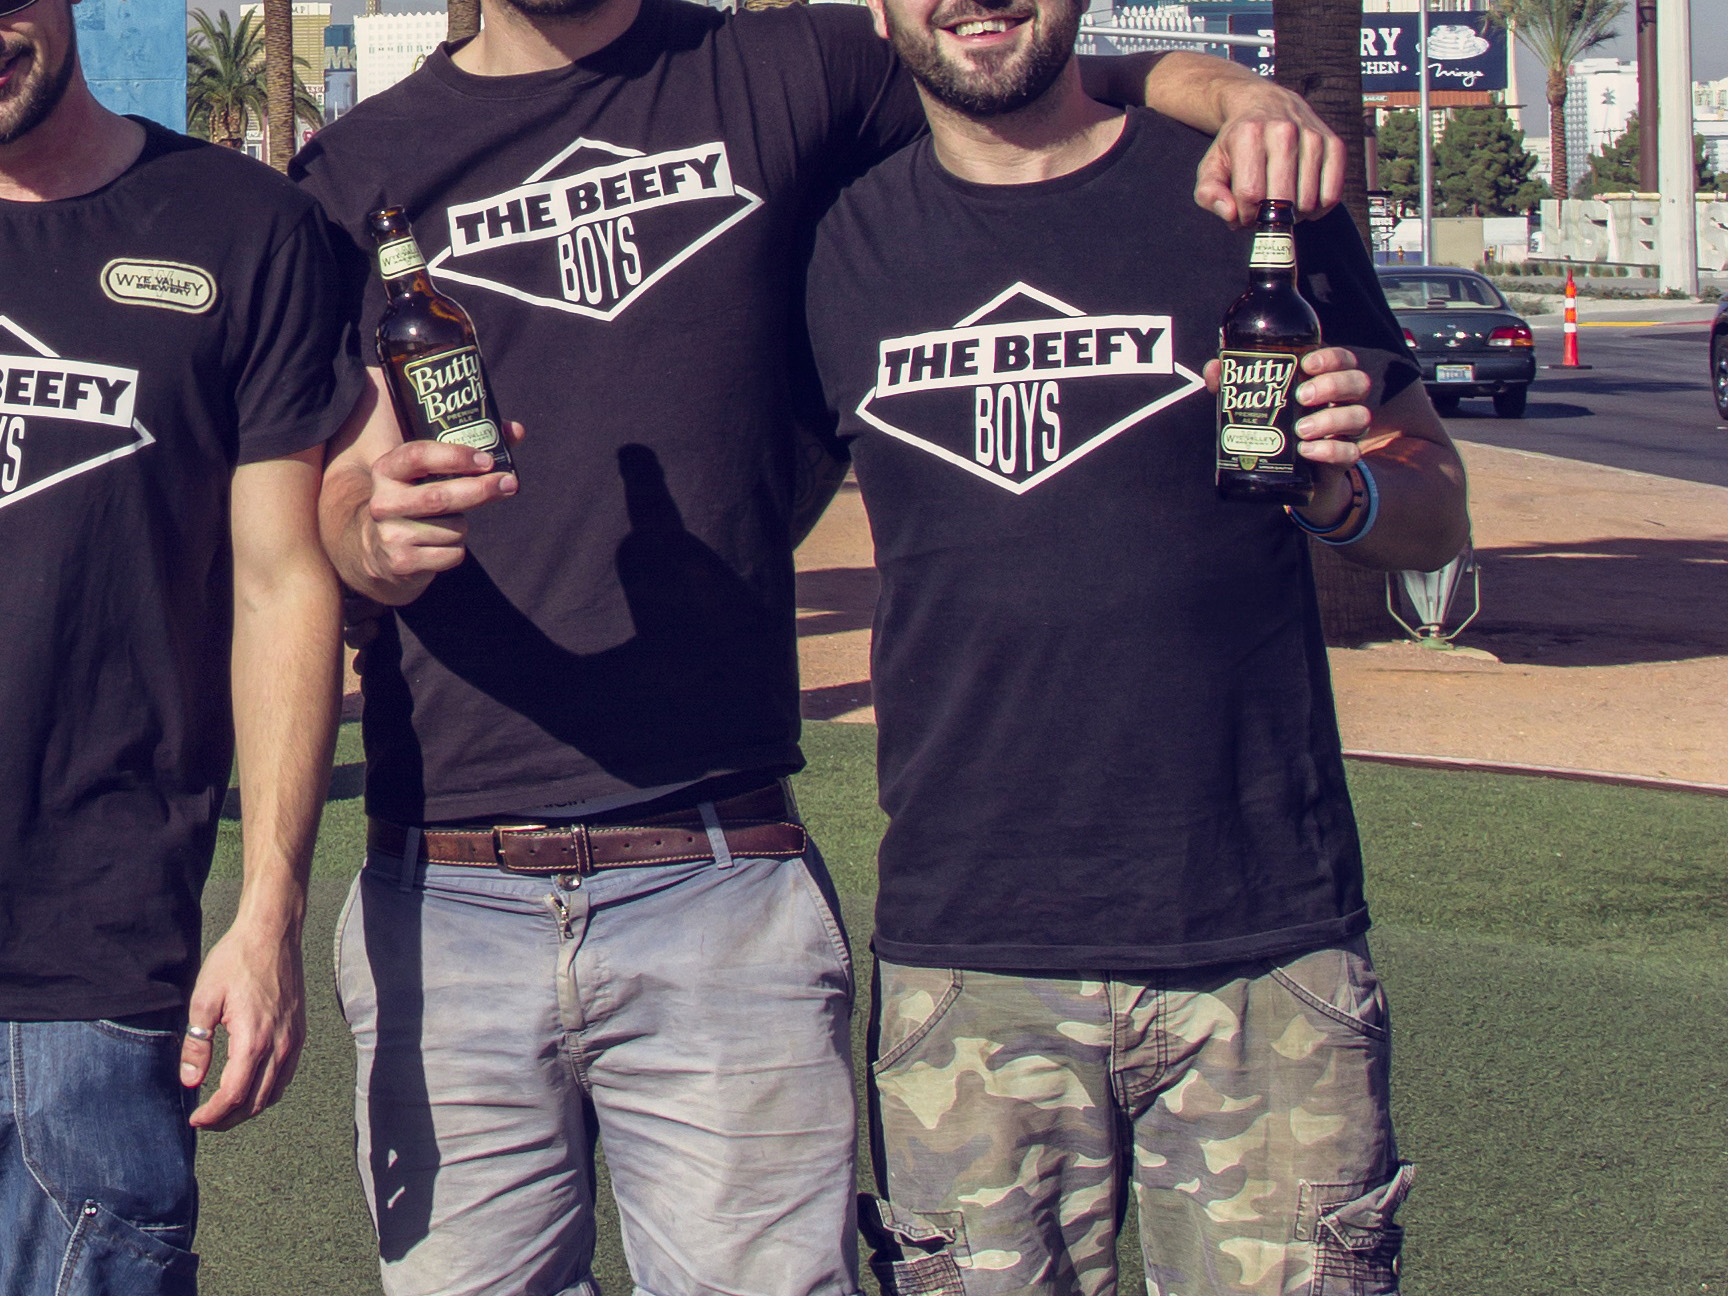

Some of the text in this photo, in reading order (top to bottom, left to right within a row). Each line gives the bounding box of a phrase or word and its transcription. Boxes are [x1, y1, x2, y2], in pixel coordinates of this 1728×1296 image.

[454, 152, 723, 246] THE BEEFY
[556, 215, 643, 305] BOYS
[115, 272, 203, 296] WYE VALLEY
[136, 283, 191, 296] BREWERY
[410, 354, 482, 396] Butty
[884, 327, 1166, 387] THE BEEFY
[1223, 358, 1294, 389] Butty
[421, 376, 487, 419] Bach
[1222, 382, 1286, 410] Bach
[974, 380, 1061, 475] BOYS
